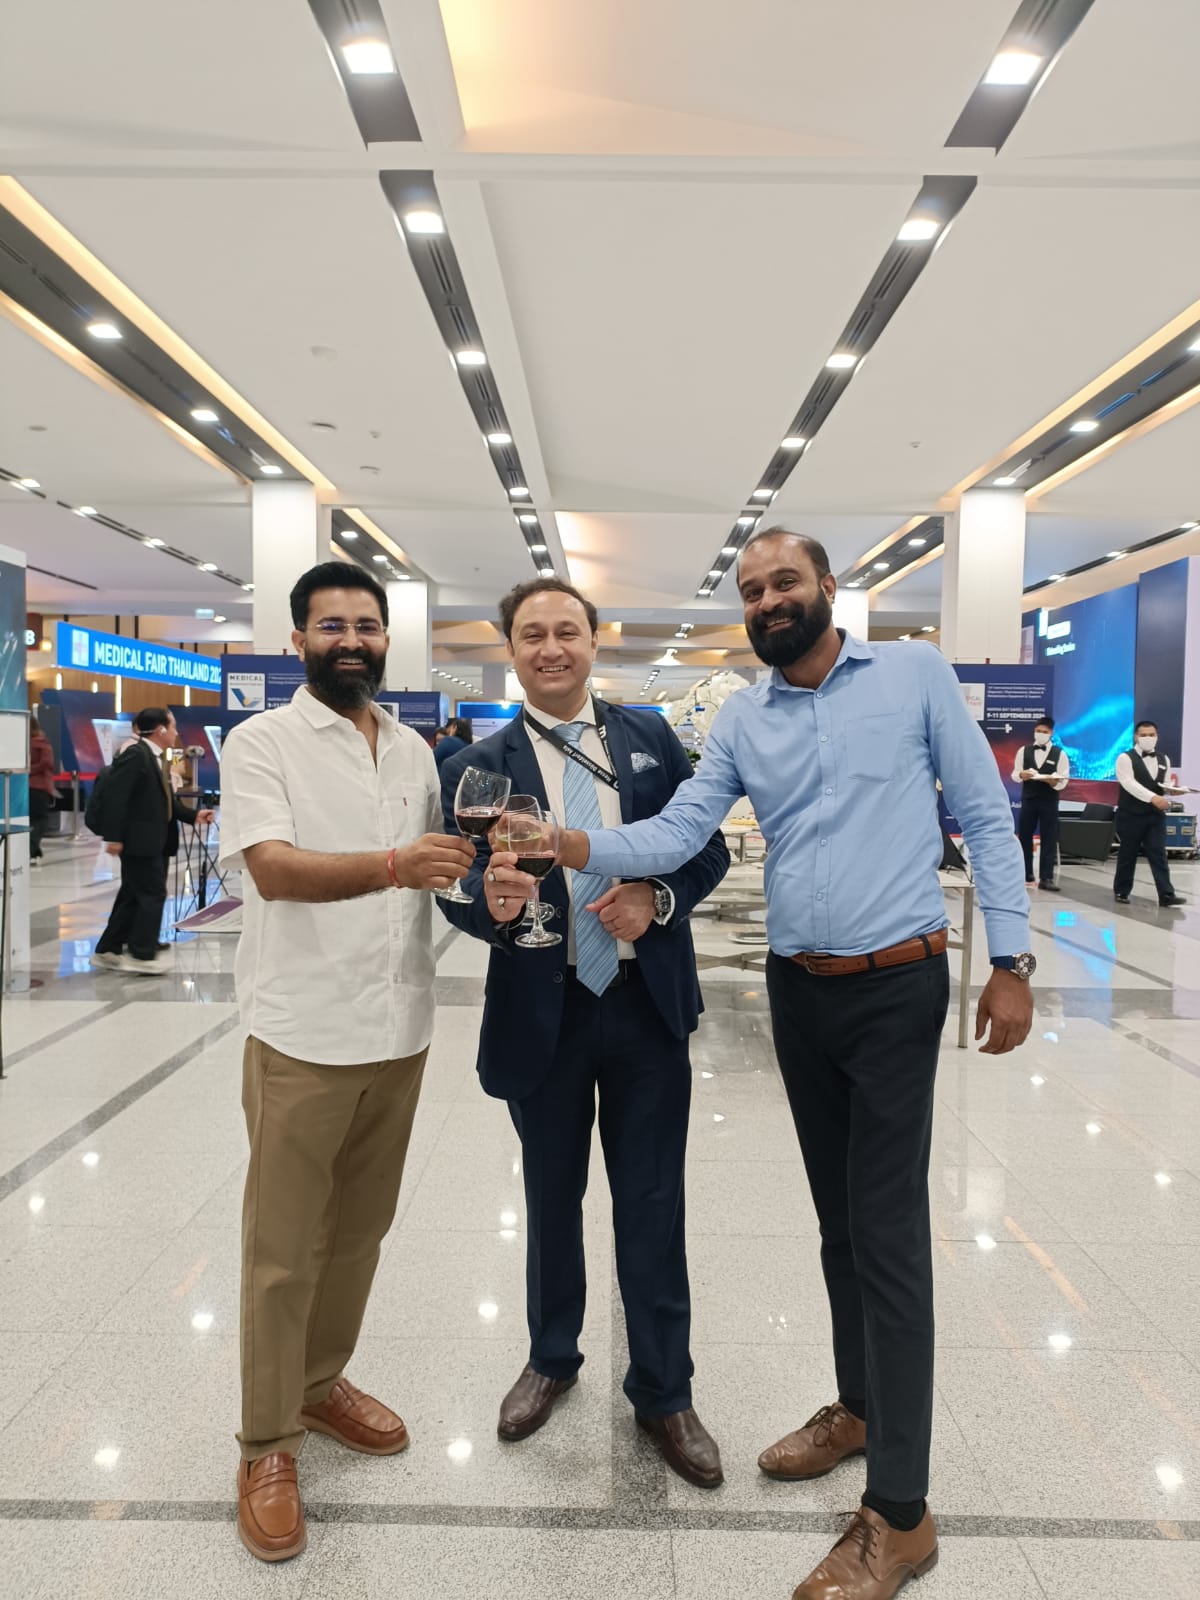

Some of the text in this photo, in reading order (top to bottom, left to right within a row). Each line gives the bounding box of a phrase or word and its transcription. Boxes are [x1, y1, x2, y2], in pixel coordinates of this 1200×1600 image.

[24, 629, 36, 646] B
[94, 641, 221, 684] MEDICAL FAIR THAILAND 202
